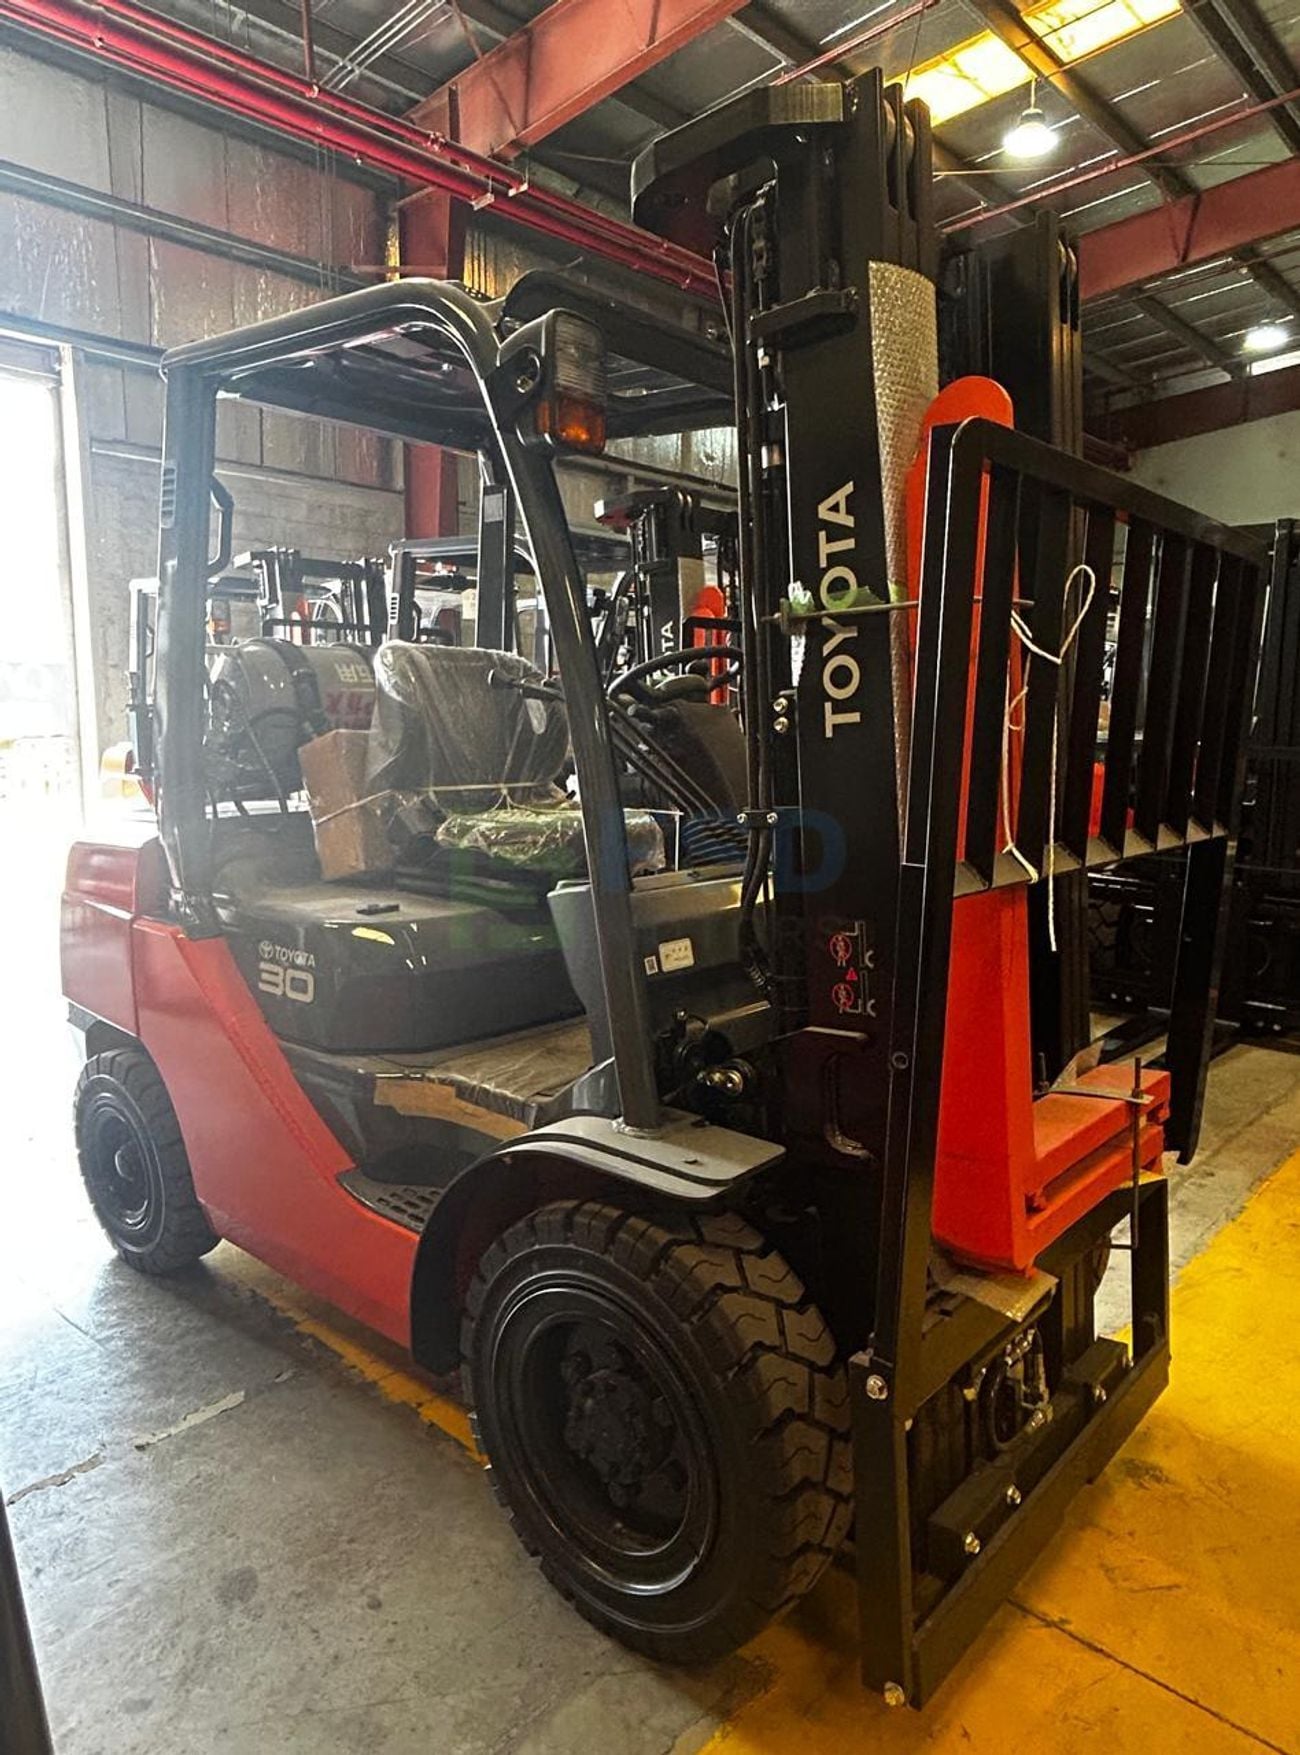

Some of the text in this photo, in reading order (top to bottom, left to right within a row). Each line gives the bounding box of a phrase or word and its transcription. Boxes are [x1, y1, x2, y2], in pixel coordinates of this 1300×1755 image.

[817, 481, 861, 738] TOYOTA
[275, 945, 316, 967] TOYOTA
[259, 962, 315, 1003] 30
